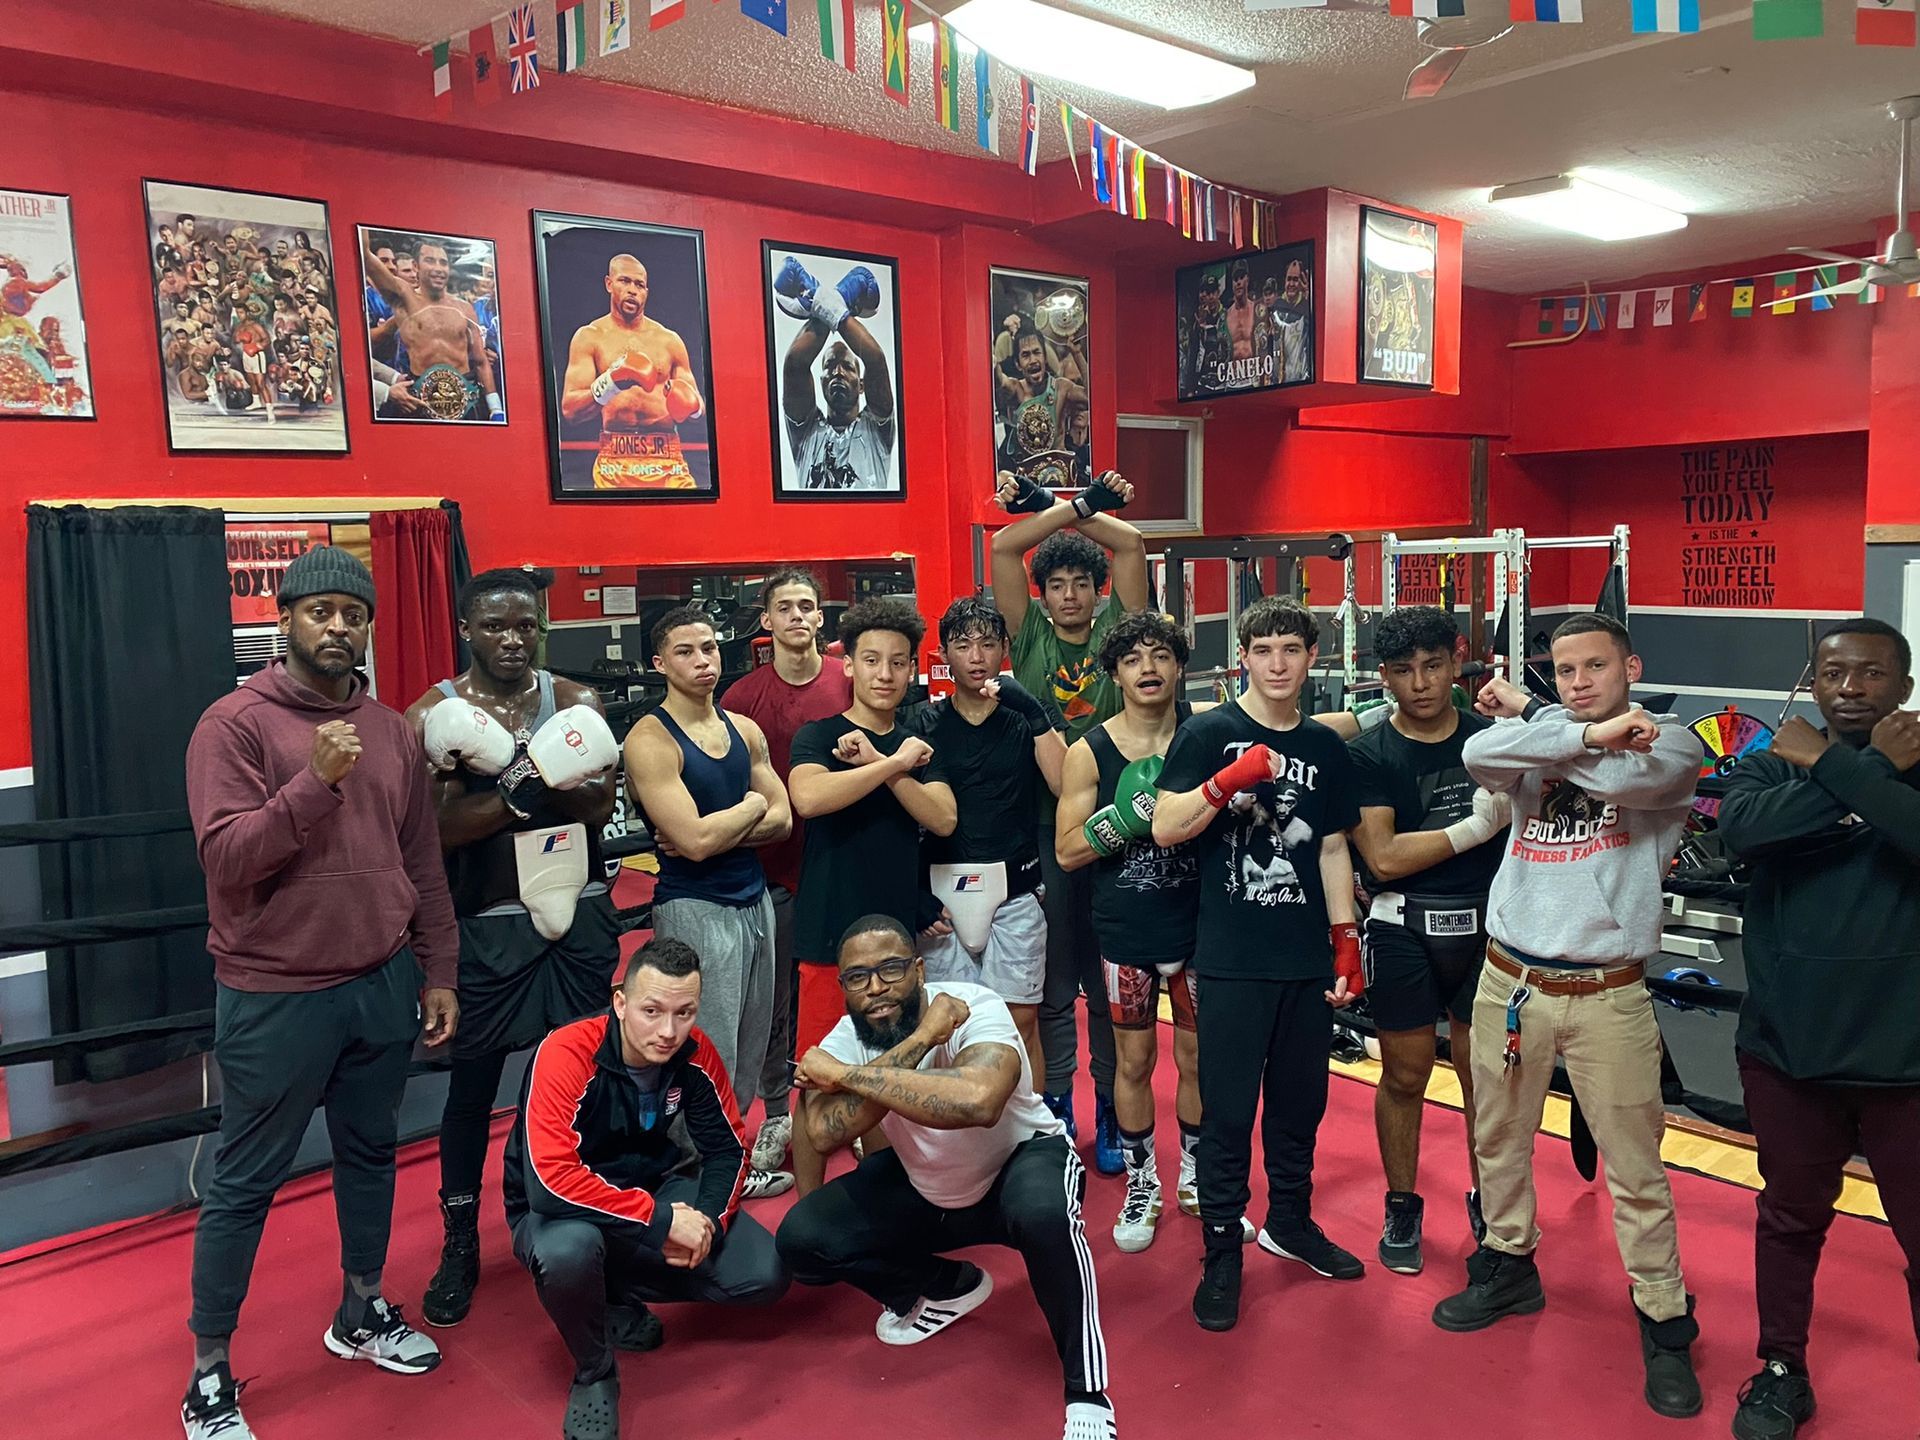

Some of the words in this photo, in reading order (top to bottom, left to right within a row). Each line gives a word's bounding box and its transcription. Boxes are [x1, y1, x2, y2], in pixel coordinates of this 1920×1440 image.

[1210, 351, 1280, 382] "CANELO"
[613, 437, 648, 454] JONES
[600, 464, 624, 475] ROY
[629, 464, 663, 475] JONES
[1680, 449, 1720, 472] THE
[1727, 446, 1774, 470] PAIN
[1682, 473, 1718, 493] YOU
[1725, 470, 1774, 491] FEEL
[1681, 491, 1774, 524] TODAY
[1709, 530, 1718, 540] IS
[1721, 529, 1739, 539] THE
[1682, 546, 1775, 565] STRENGTH
[1682, 567, 1718, 587] YOU
[1725, 566, 1775, 586] FEEL
[1682, 588, 1775, 606] TOMORROW
[1511, 839, 1567, 864] FITNESS
